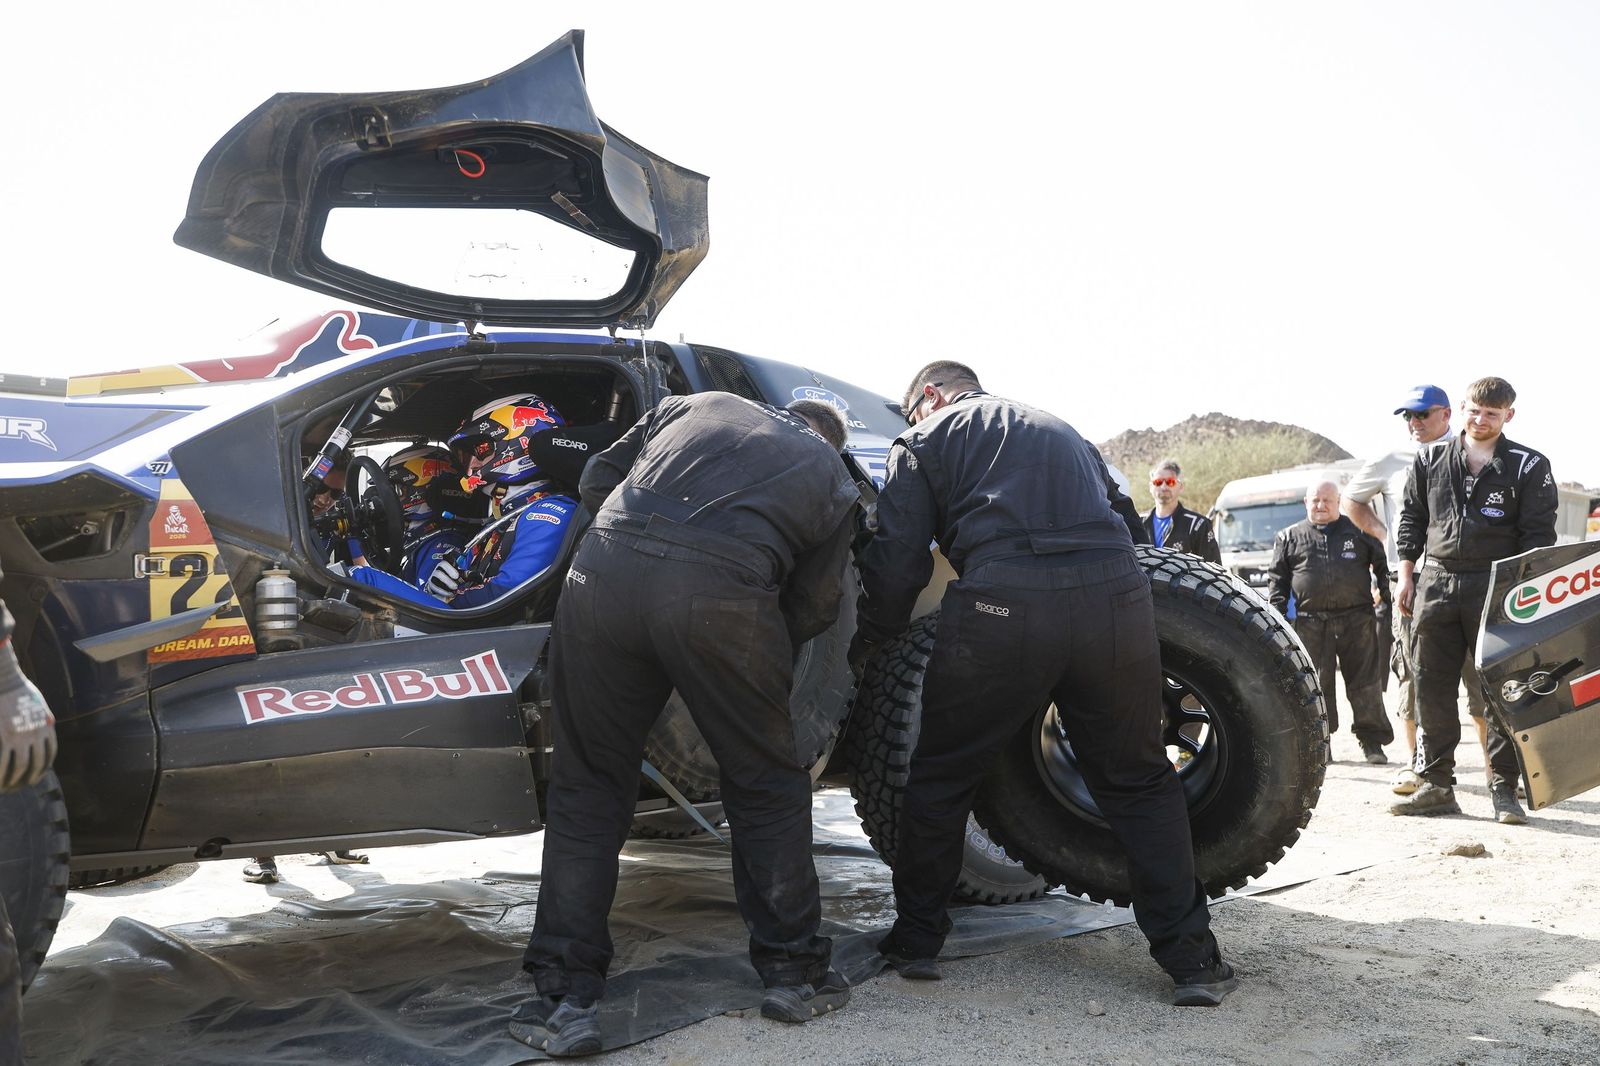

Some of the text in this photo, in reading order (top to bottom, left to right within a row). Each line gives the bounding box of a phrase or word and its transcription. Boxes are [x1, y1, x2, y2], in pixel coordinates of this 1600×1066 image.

[552, 438, 588, 451] RECARO
[150, 462, 169, 473] 371
[975, 601, 1009, 616] sparco
[241, 652, 509, 722] Red Bull
